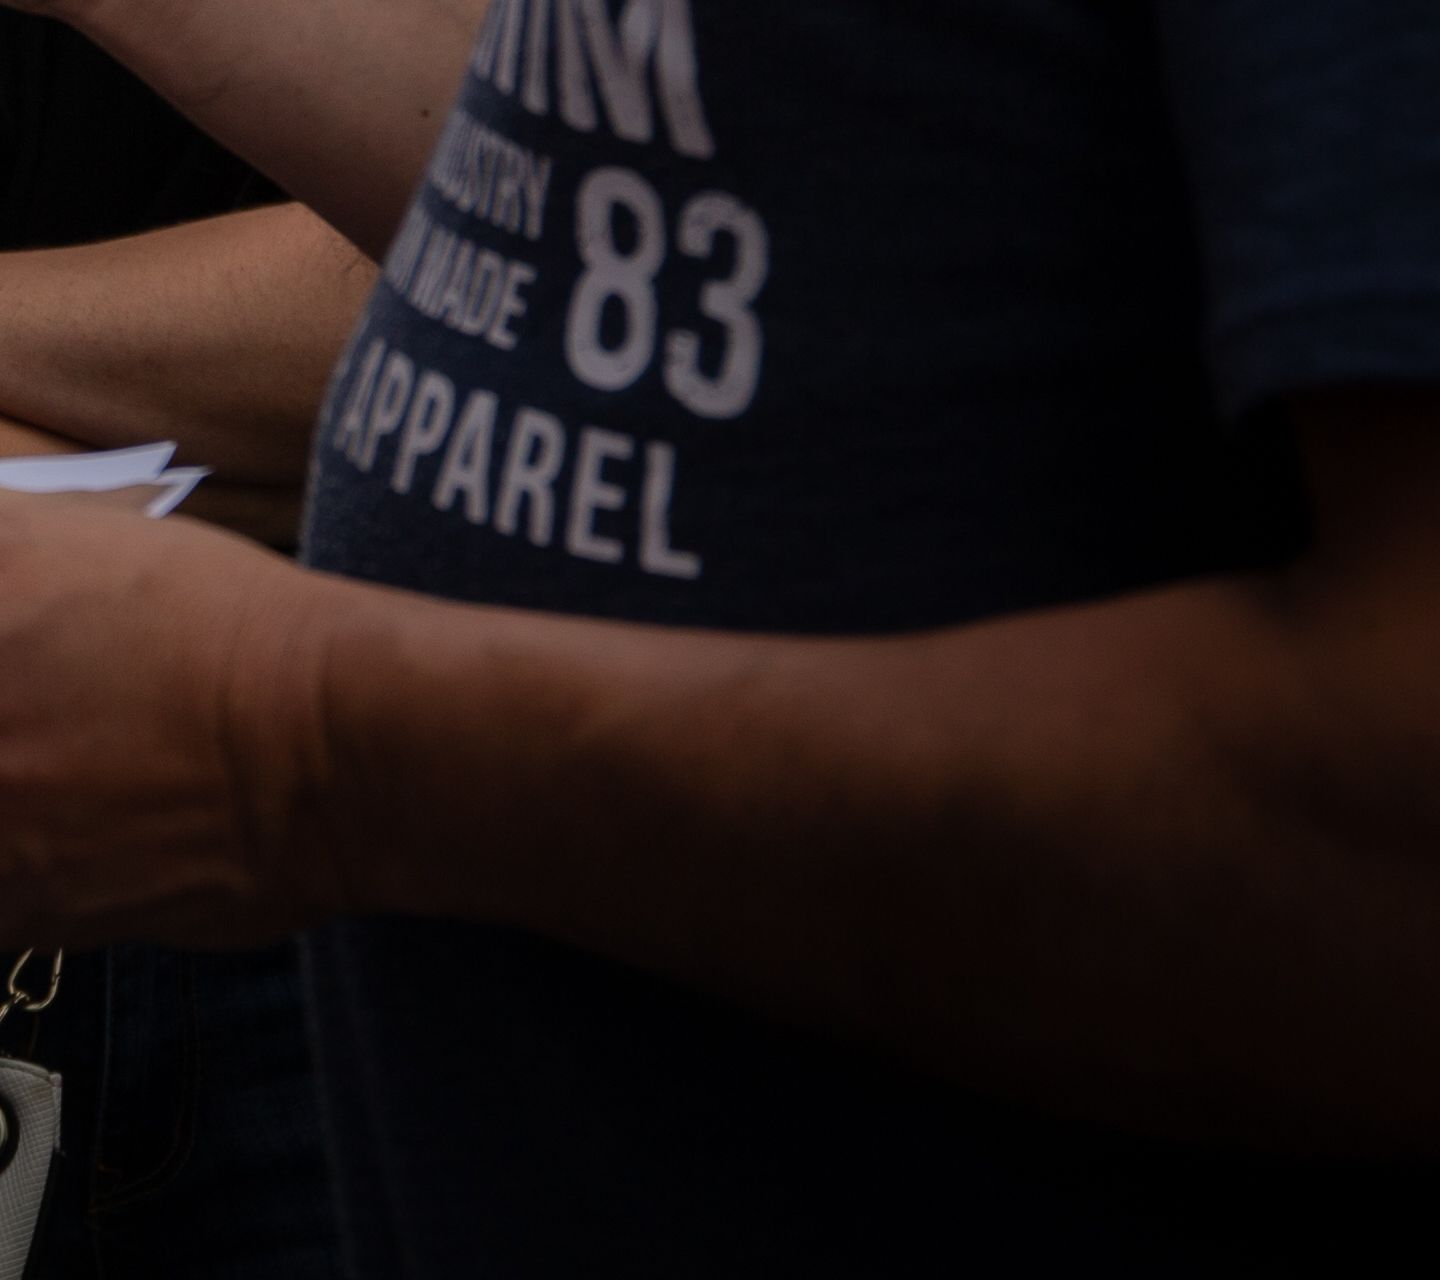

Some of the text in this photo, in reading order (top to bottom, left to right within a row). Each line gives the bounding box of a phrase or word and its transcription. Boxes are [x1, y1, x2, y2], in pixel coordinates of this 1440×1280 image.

[411, 223, 539, 353] MADE
[563, 165, 771, 420] 83
[332, 335, 704, 582] APPAREL
